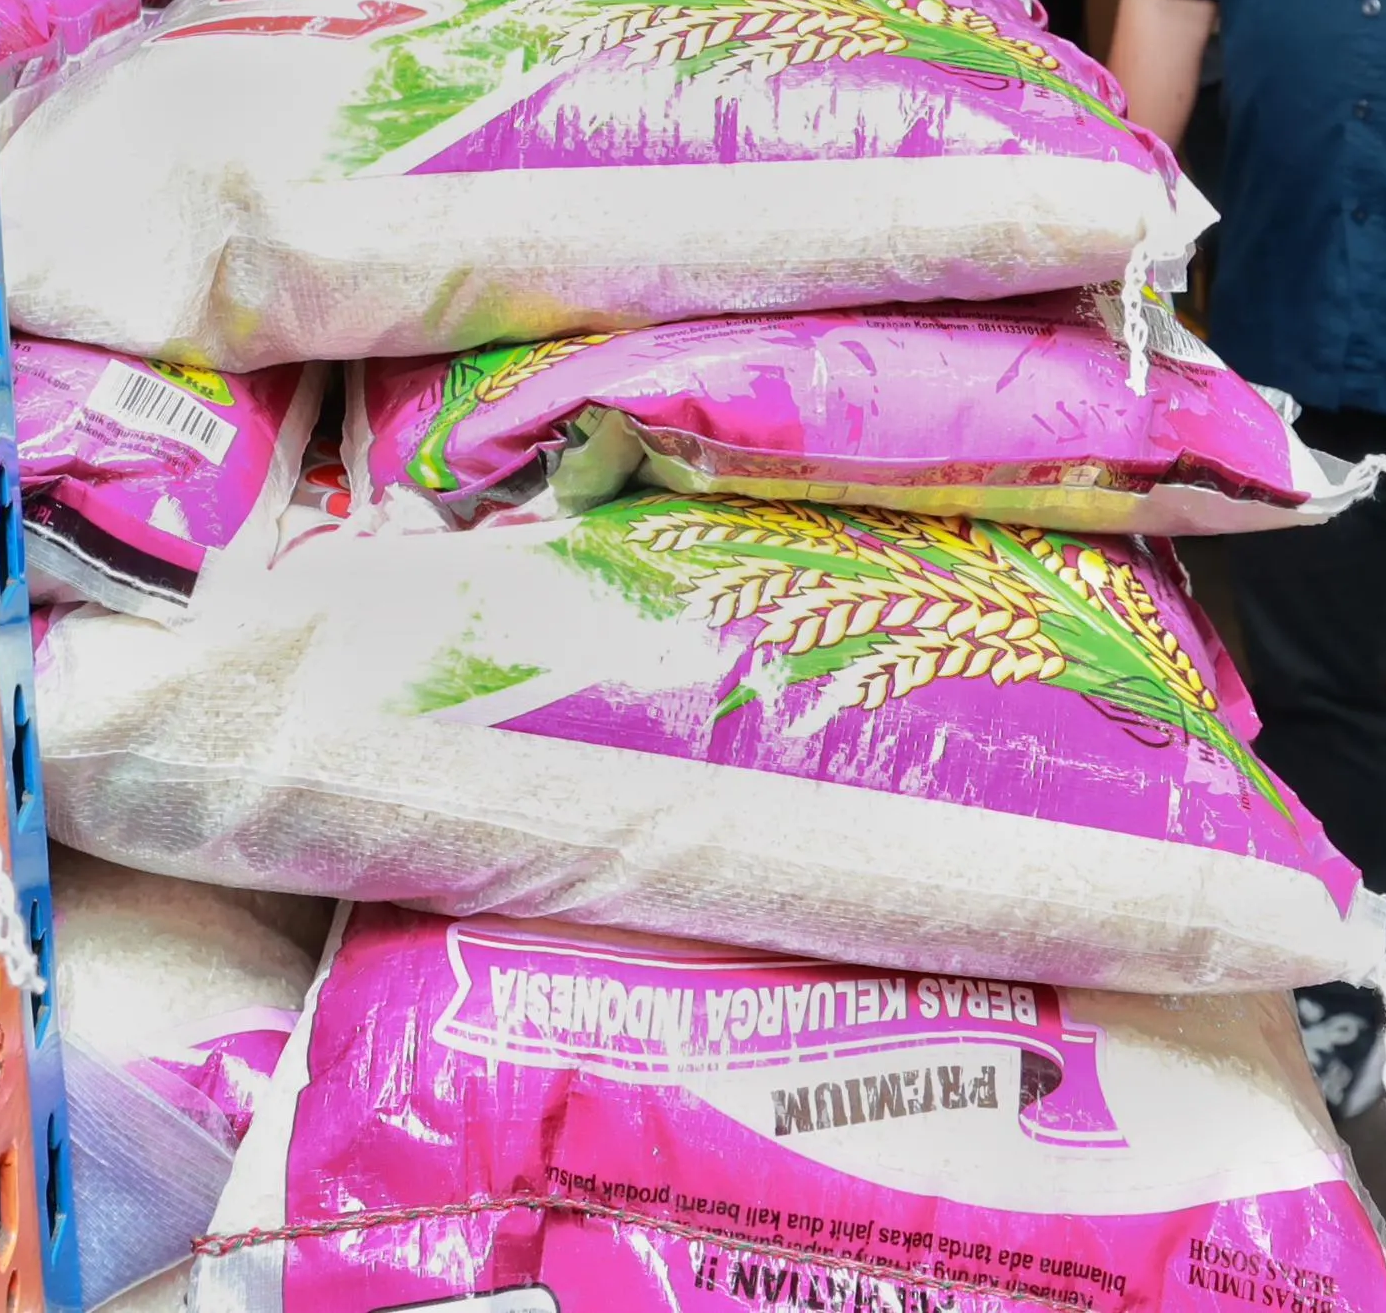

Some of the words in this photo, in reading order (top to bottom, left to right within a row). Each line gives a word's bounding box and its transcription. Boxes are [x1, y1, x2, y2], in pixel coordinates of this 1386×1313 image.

[913, 320, 970, 333] Konsumen
[489, 965, 695, 1042] INDONESIA
[705, 977, 908, 1041] KELUARGA
[917, 976, 1039, 1027] BERAS
[770, 1065, 999, 1137] PREMIUM
[602, 1180, 671, 1205] produk
[675, 1193, 741, 1223] berarti
[744, 1206, 782, 1232] kali
[787, 1211, 825, 1235] dua
[828, 1219, 876, 1244] jahit
[878, 1226, 933, 1251] bekas
[937, 1236, 992, 1265] tanda
[998, 1248, 1034, 1270] ada
[1189, 1238, 1262, 1277] SOSOH
[1040, 1257, 1127, 1296] bilamana
[1188, 1263, 1256, 1303] UMUM
